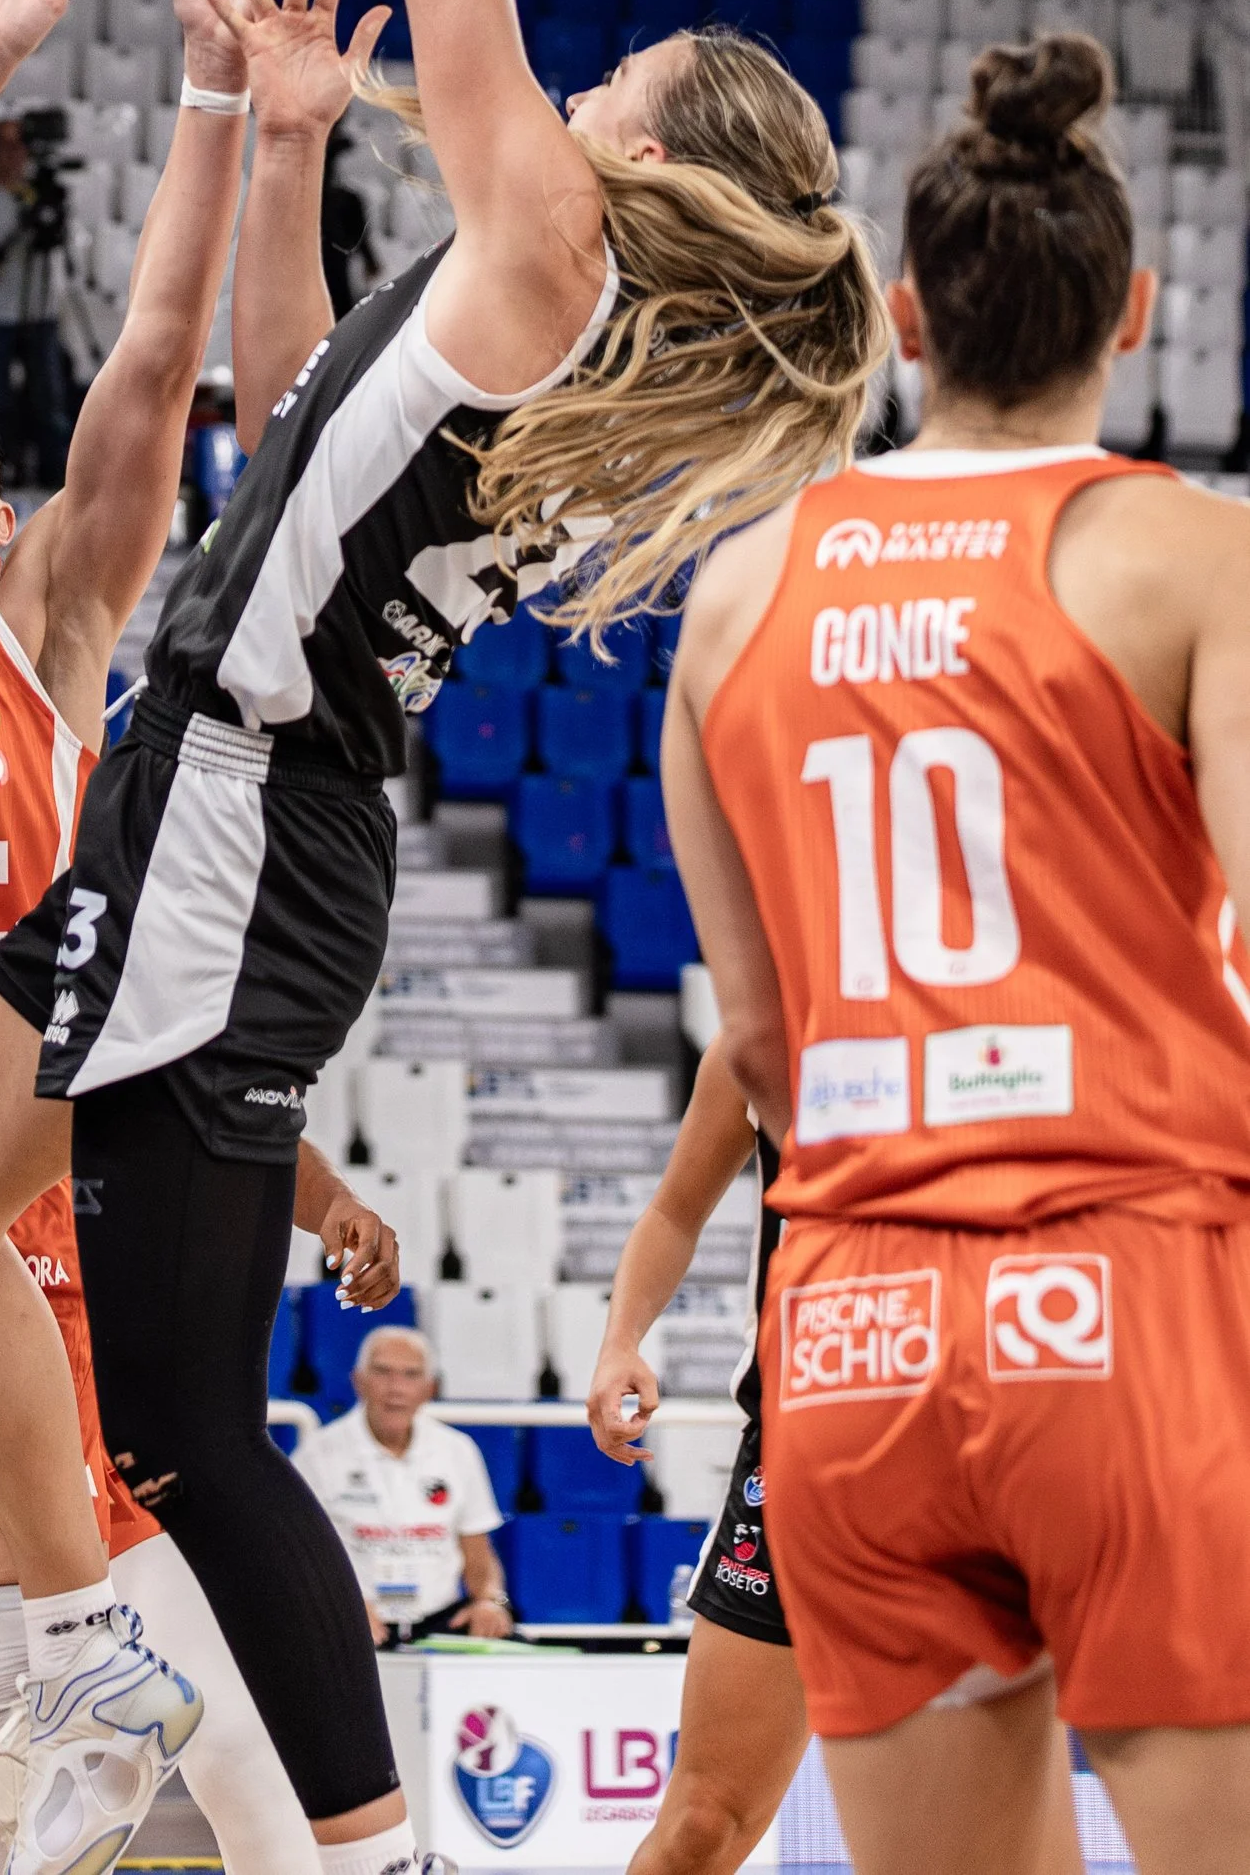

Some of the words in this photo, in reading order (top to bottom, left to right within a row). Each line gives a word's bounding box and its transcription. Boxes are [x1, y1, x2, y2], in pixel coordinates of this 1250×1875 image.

[800, 726, 1022, 1001] 10
[796, 1288, 910, 1338] PISCINE
[791, 1325, 937, 1392] SCHIO
[715, 1564, 769, 1595] ROSETO
